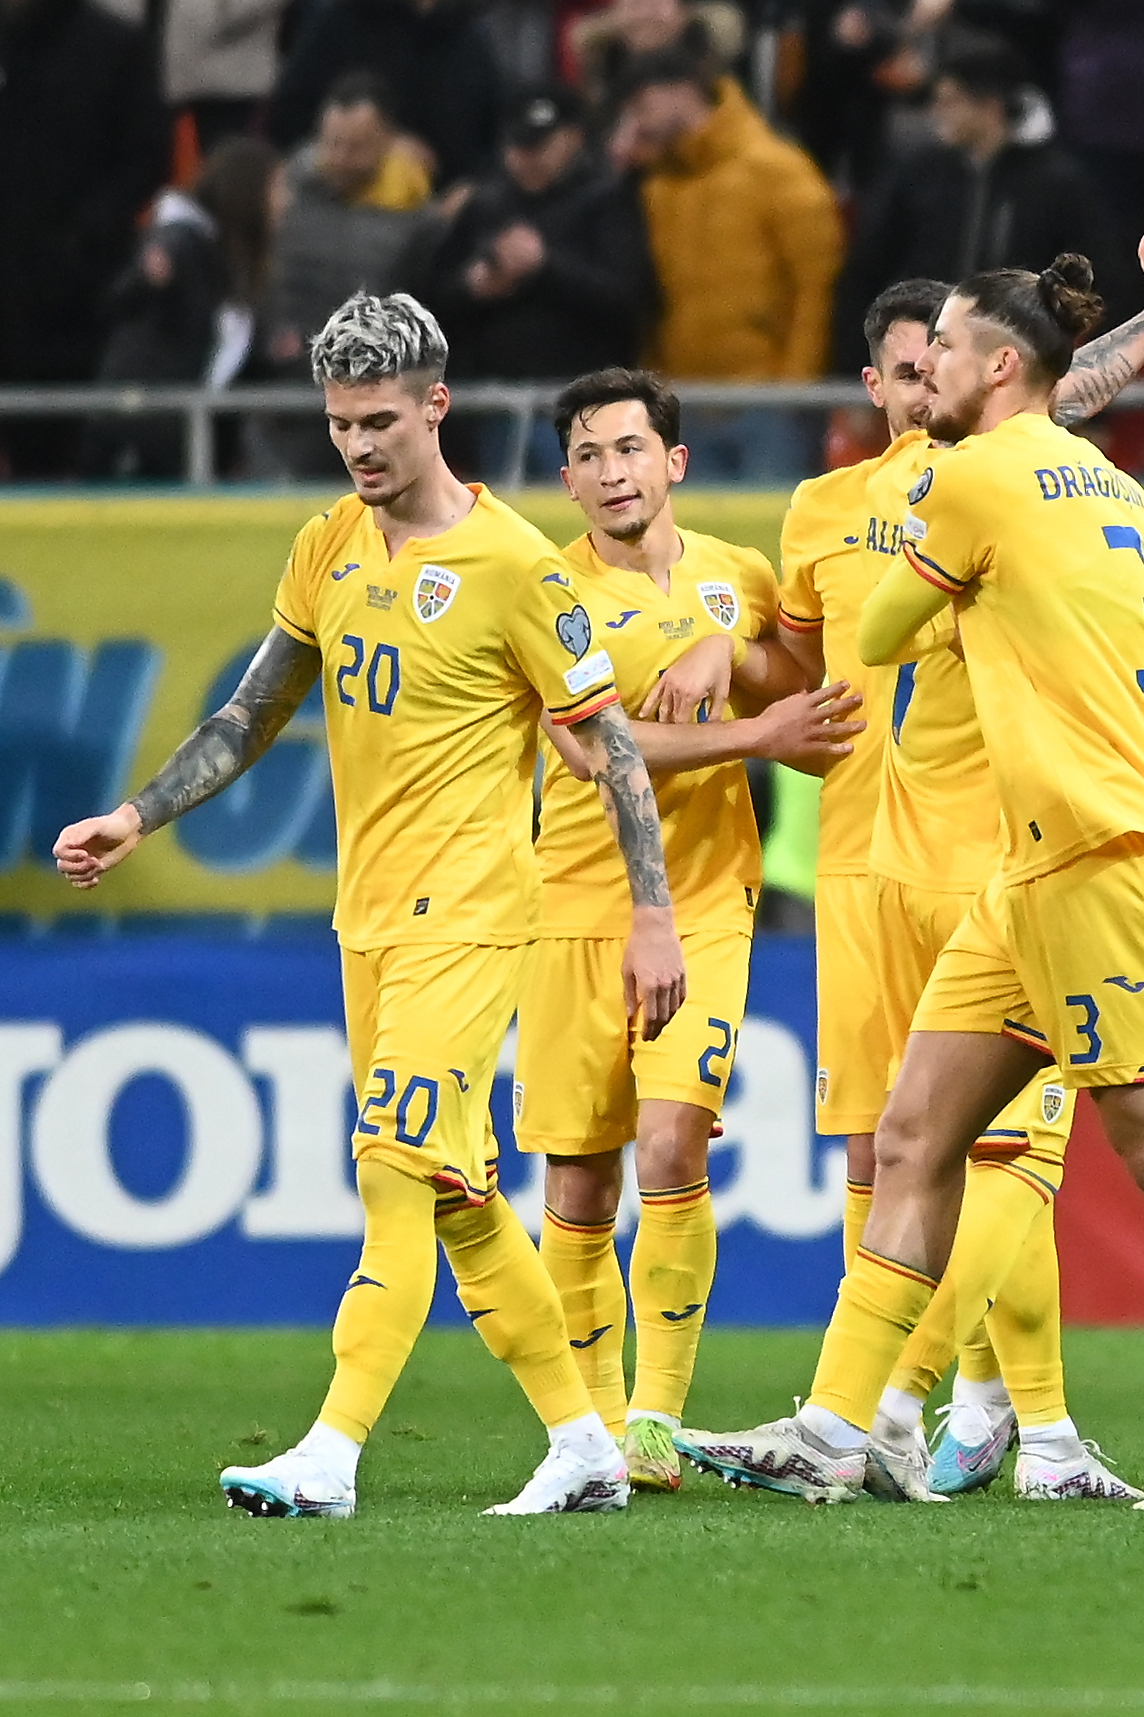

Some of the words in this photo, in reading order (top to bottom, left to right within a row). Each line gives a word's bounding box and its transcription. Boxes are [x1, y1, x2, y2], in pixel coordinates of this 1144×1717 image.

[336, 633, 401, 716] 20
[697, 1016, 739, 1088] 2
[1065, 994, 1103, 1065] 3
[358, 1068, 439, 1148] 20
